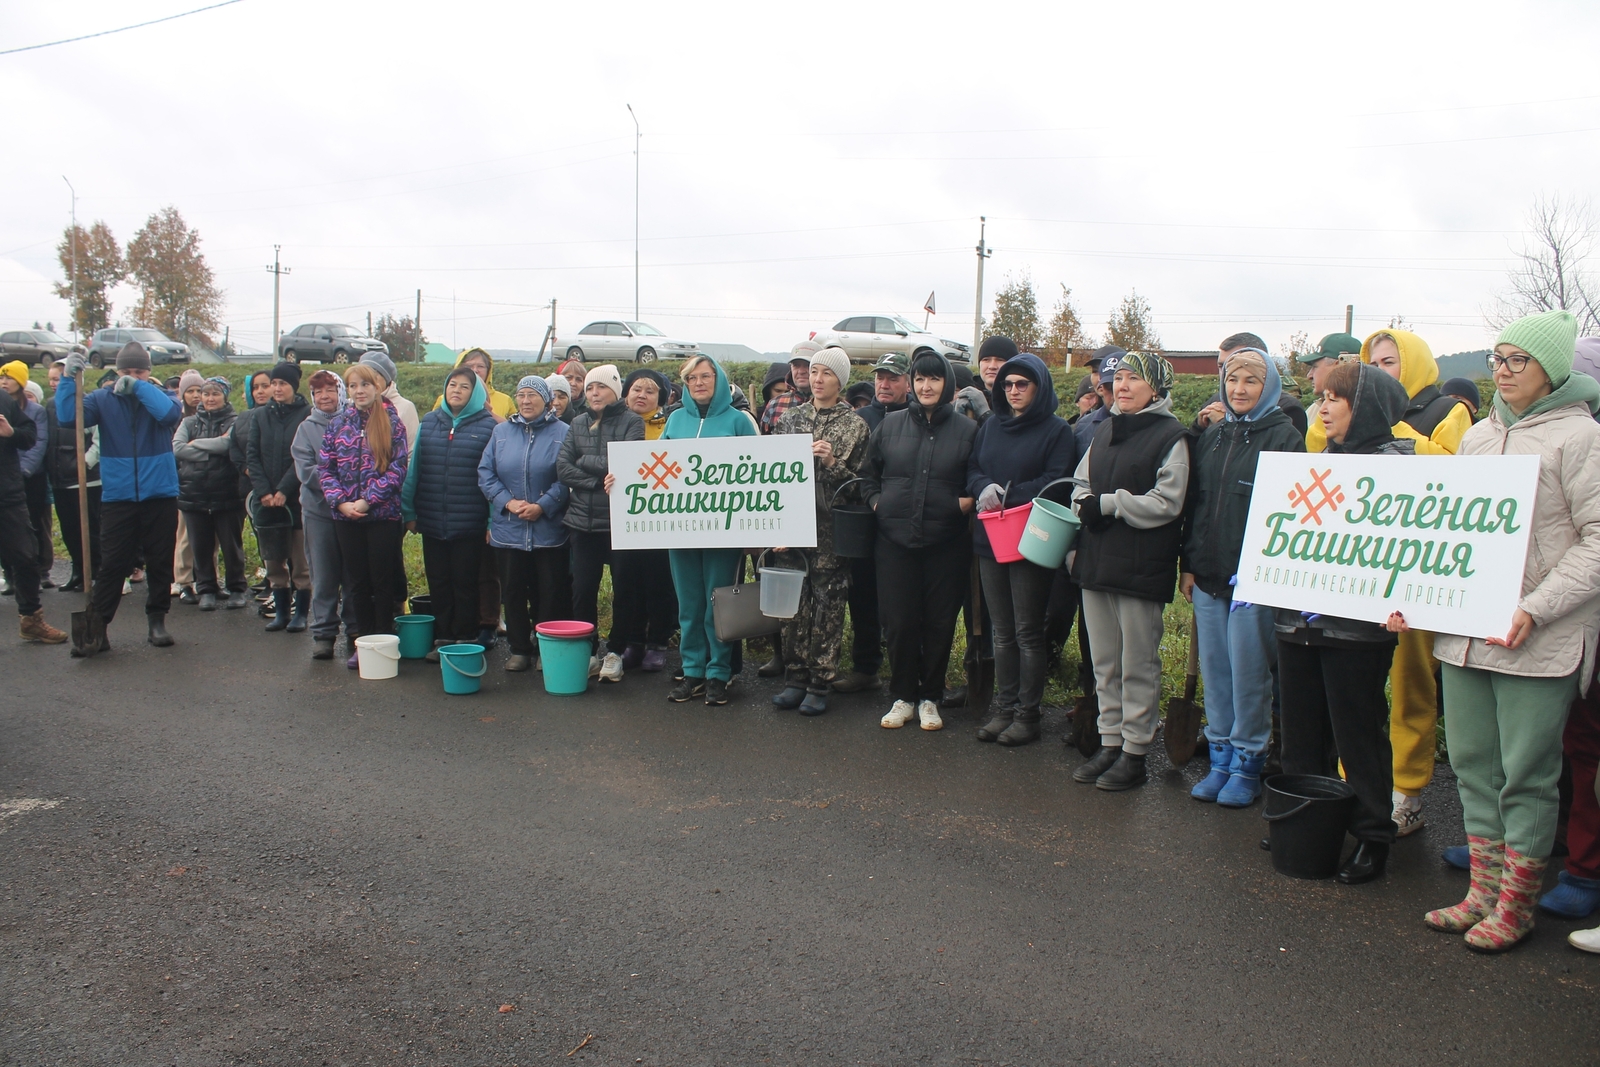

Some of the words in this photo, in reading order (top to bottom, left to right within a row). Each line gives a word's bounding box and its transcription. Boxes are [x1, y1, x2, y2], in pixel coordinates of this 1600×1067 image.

[882, 353, 896, 364] Z
[684, 454, 808, 486] Зелёная
[625, 483, 784, 530] Башкирия
[626, 517, 720, 533] ЭКОЛОГИЧЕСКИЙ
[739, 517, 782, 530] ПРОЕКТ
[1345, 476, 1520, 534] Зелёная
[1261, 512, 1475, 598] Башкирия
[1254, 565, 1377, 597] ЭКОЛОГИЧЕСКИЙ
[1404, 583, 1467, 609] ПРОЕКТ
